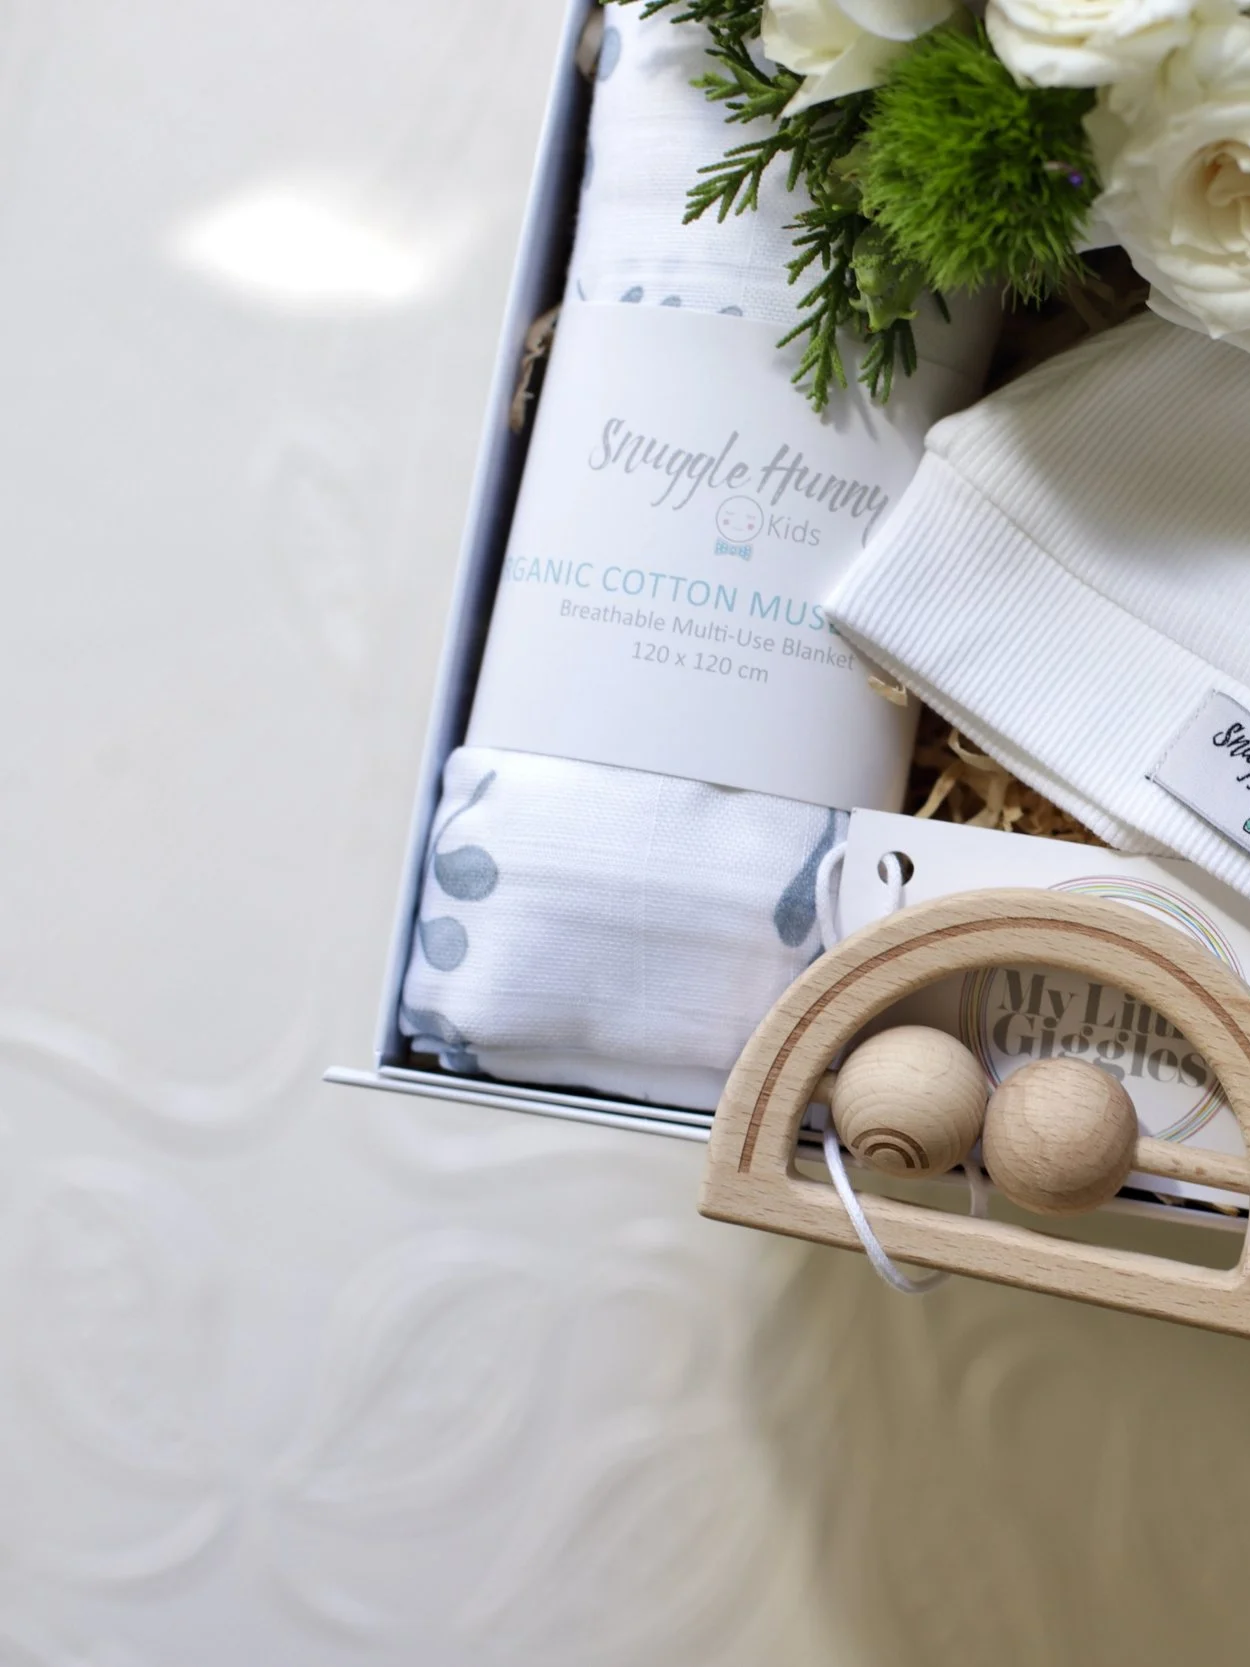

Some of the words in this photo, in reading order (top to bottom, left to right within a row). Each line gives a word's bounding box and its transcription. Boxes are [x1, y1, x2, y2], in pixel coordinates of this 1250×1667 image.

[588, 418, 751, 511] Snuggle
[757, 444, 889, 549] Hunny
[766, 513, 822, 547] Kids
[602, 565, 738, 613] COTTON
[559, 599, 667, 632] Breathable
[671, 616, 776, 653] Multi-Use
[781, 637, 855, 671] Blanket
[631, 641, 670, 665] 120
[674, 652, 687, 667] x
[692, 652, 733, 676] 120
[737, 662, 769, 684] cm
[997, 969, 1077, 1026] My
